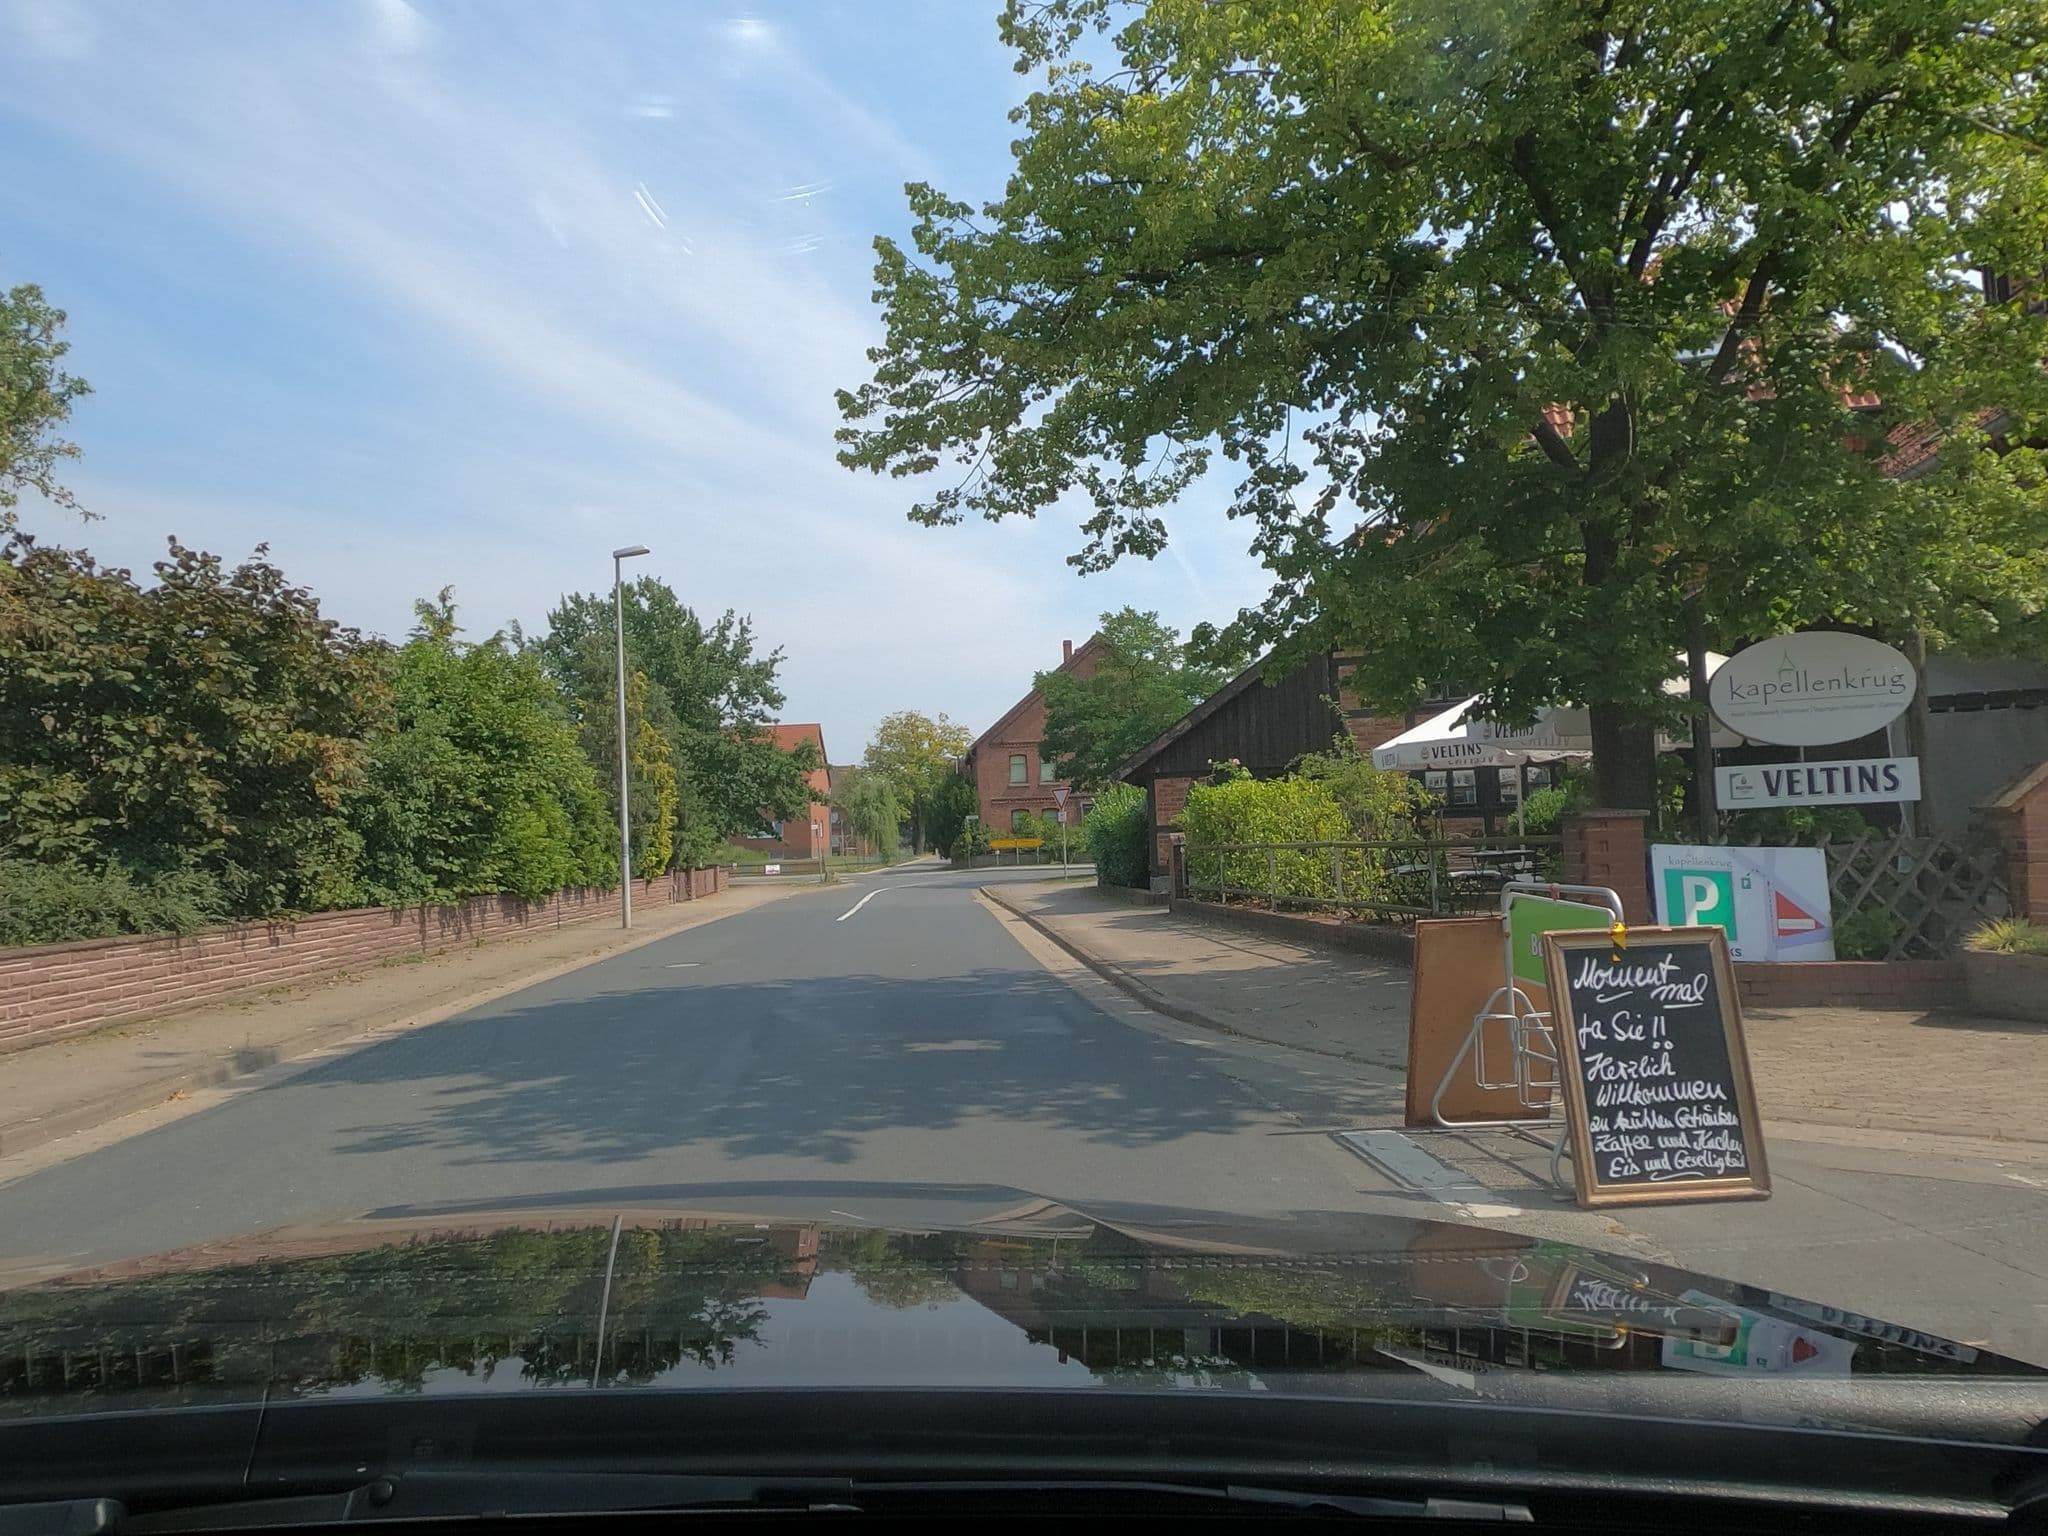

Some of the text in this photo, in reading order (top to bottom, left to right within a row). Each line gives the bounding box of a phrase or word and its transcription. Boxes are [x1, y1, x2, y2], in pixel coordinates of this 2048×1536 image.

[1729, 667, 1906, 706] kapellenkrug
[1431, 743, 1483, 759] VELTINS
[1761, 764, 1900, 797] VELTINS
[1574, 953, 1708, 1001] Moment mal
[1612, 1010, 1647, 1041] Sie
[1584, 1052, 1676, 1081] Herzlich
[1596, 1080, 1728, 1107] Willkommen
[1657, 1131, 1691, 1149] und
[1608, 1157, 1641, 1178] Eis
[1644, 1151, 1673, 1172] und
